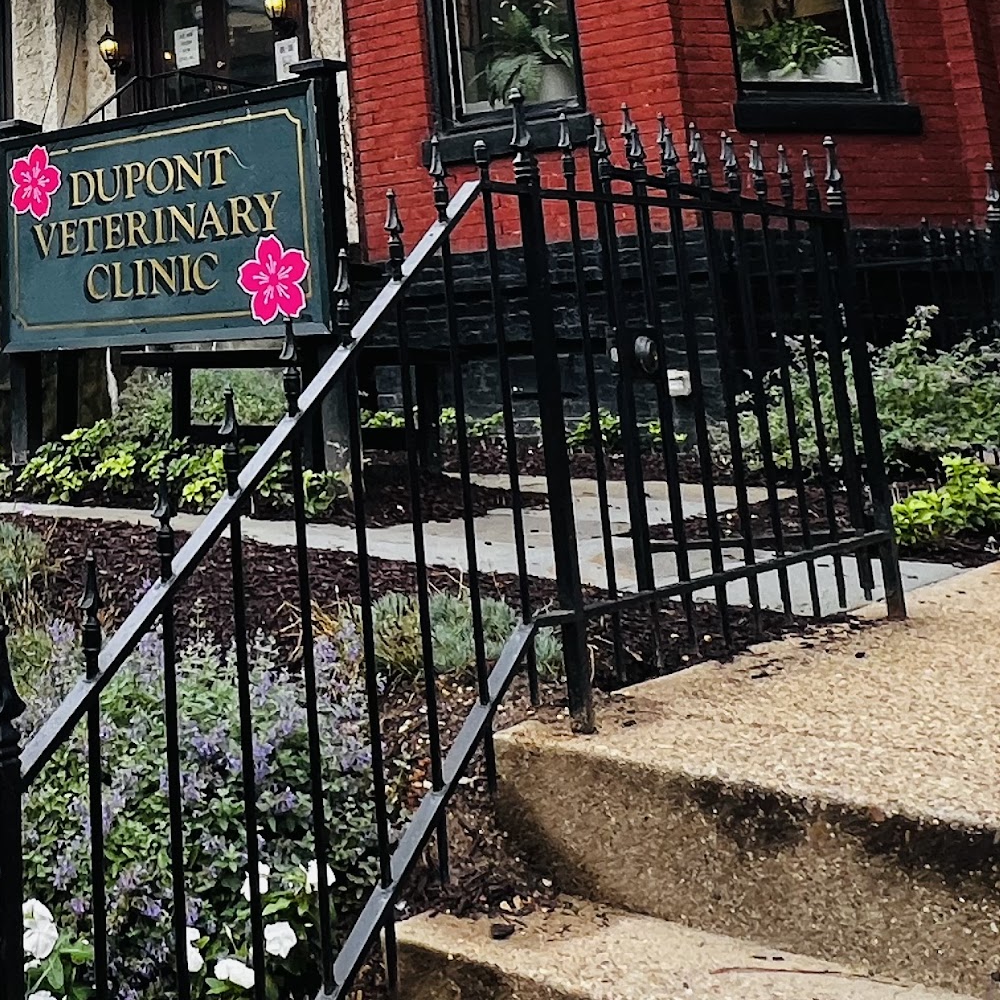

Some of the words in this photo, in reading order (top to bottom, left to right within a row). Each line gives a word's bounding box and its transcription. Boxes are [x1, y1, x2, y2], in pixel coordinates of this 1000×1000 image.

[69, 147, 232, 207] DUPONT
[33, 190, 281, 257] VETERINARY
[86, 252, 220, 301] CLINIC
